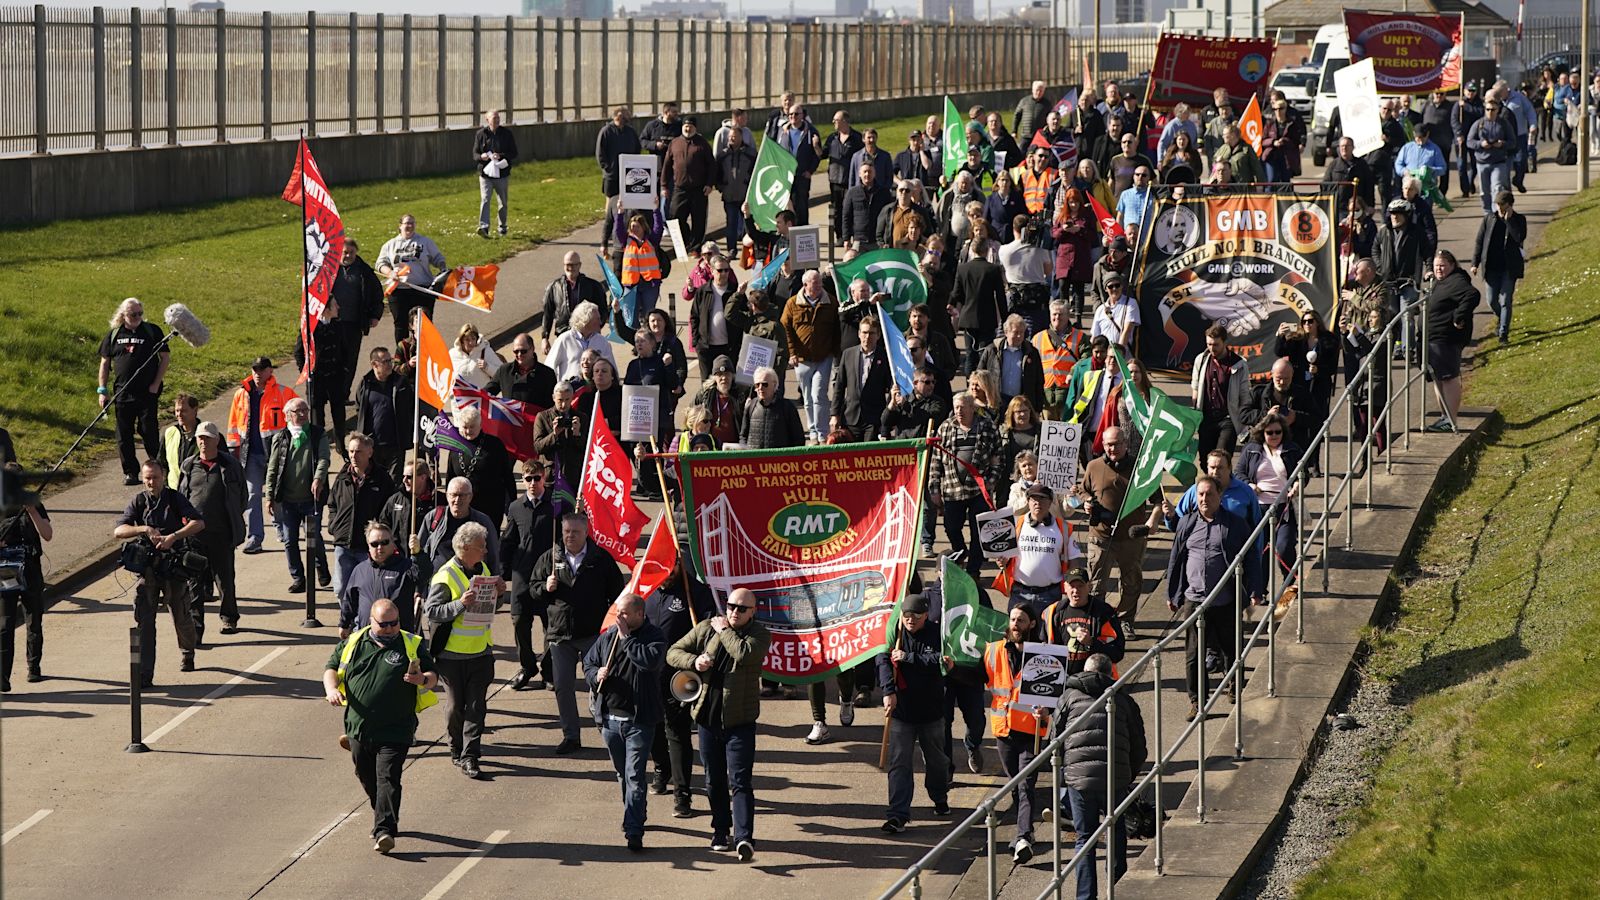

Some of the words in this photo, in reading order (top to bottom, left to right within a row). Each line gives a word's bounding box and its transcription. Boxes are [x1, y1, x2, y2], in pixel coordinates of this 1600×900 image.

[1368, 25, 1386, 34] HULL
[1406, 24, 1440, 38] DISTRICT
[1383, 35, 1422, 45] UNITY
[1194, 49, 1238, 60] BRIGADES
[1396, 47, 1408, 55] IS
[1201, 60, 1228, 70] UNION
[1216, 209, 1268, 232] GMB
[1297, 211, 1313, 233] 8
[1296, 231, 1316, 242] hrs.
[1169, 246, 1210, 273] HULL
[1253, 240, 1313, 279] BRANCH
[1208, 261, 1274, 276] GMB@WORK
[1163, 286, 1192, 310] EST
[1041, 444, 1077, 459] PLUNDER
[693, 465, 755, 478] NATIONAL
[760, 462, 799, 474] UNION
[803, 460, 818, 472] OF
[822, 458, 849, 471] RAIL
[854, 453, 916, 468] MARITIME
[1039, 459, 1072, 474] PILLAGE
[721, 478, 747, 490] AND
[754, 474, 828, 488] TRANSPORT
[834, 469, 892, 483] WORKERS
[1038, 472, 1074, 489] PIRATES
[783, 488, 829, 504] HULL
[784, 513, 841, 536] RMT
[761, 534, 793, 558] RAIL
[801, 528, 859, 561] BRANCH
[818, 602, 837, 616] RMT
[769, 637, 822, 657] KERS
[828, 629, 849, 648] OF
[826, 634, 869, 664] UNITE
